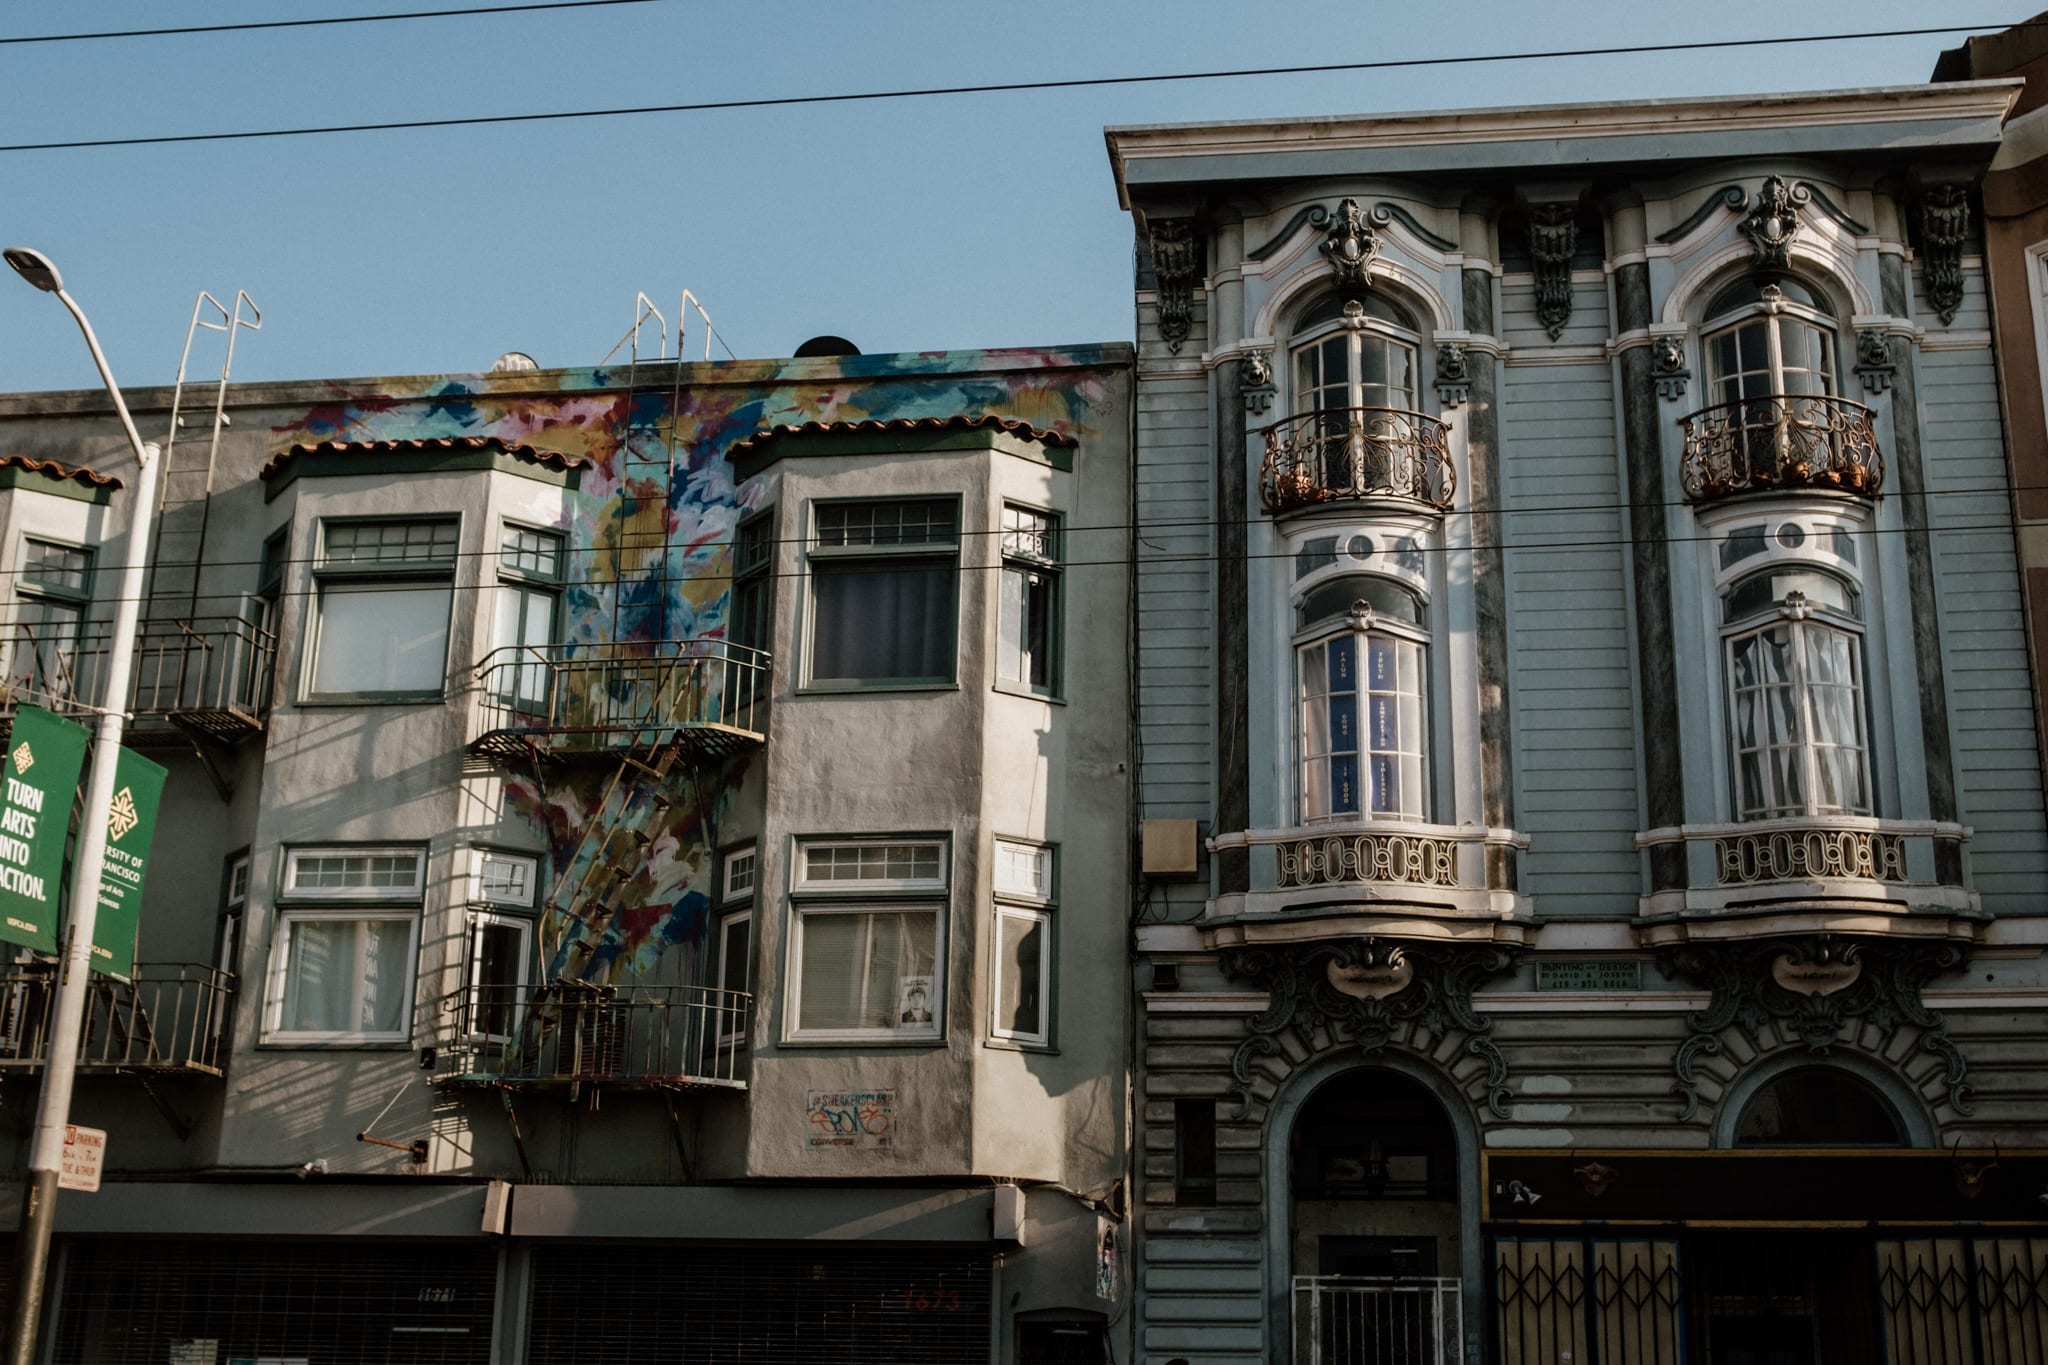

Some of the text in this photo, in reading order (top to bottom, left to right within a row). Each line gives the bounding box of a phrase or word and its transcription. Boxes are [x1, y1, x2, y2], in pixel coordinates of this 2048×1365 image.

[7, 777, 44, 813] TURN
[0, 807, 36, 839] ARTS
[0, 834, 29, 867] INTO
[104, 845, 143, 869] ERSITY OF
[0, 864, 47, 902] ACTION.
[102, 858, 140, 883] RANCISCO
[1599, 962, 1636, 971] DESIGN
[76, 1133, 103, 1148] PARKING
